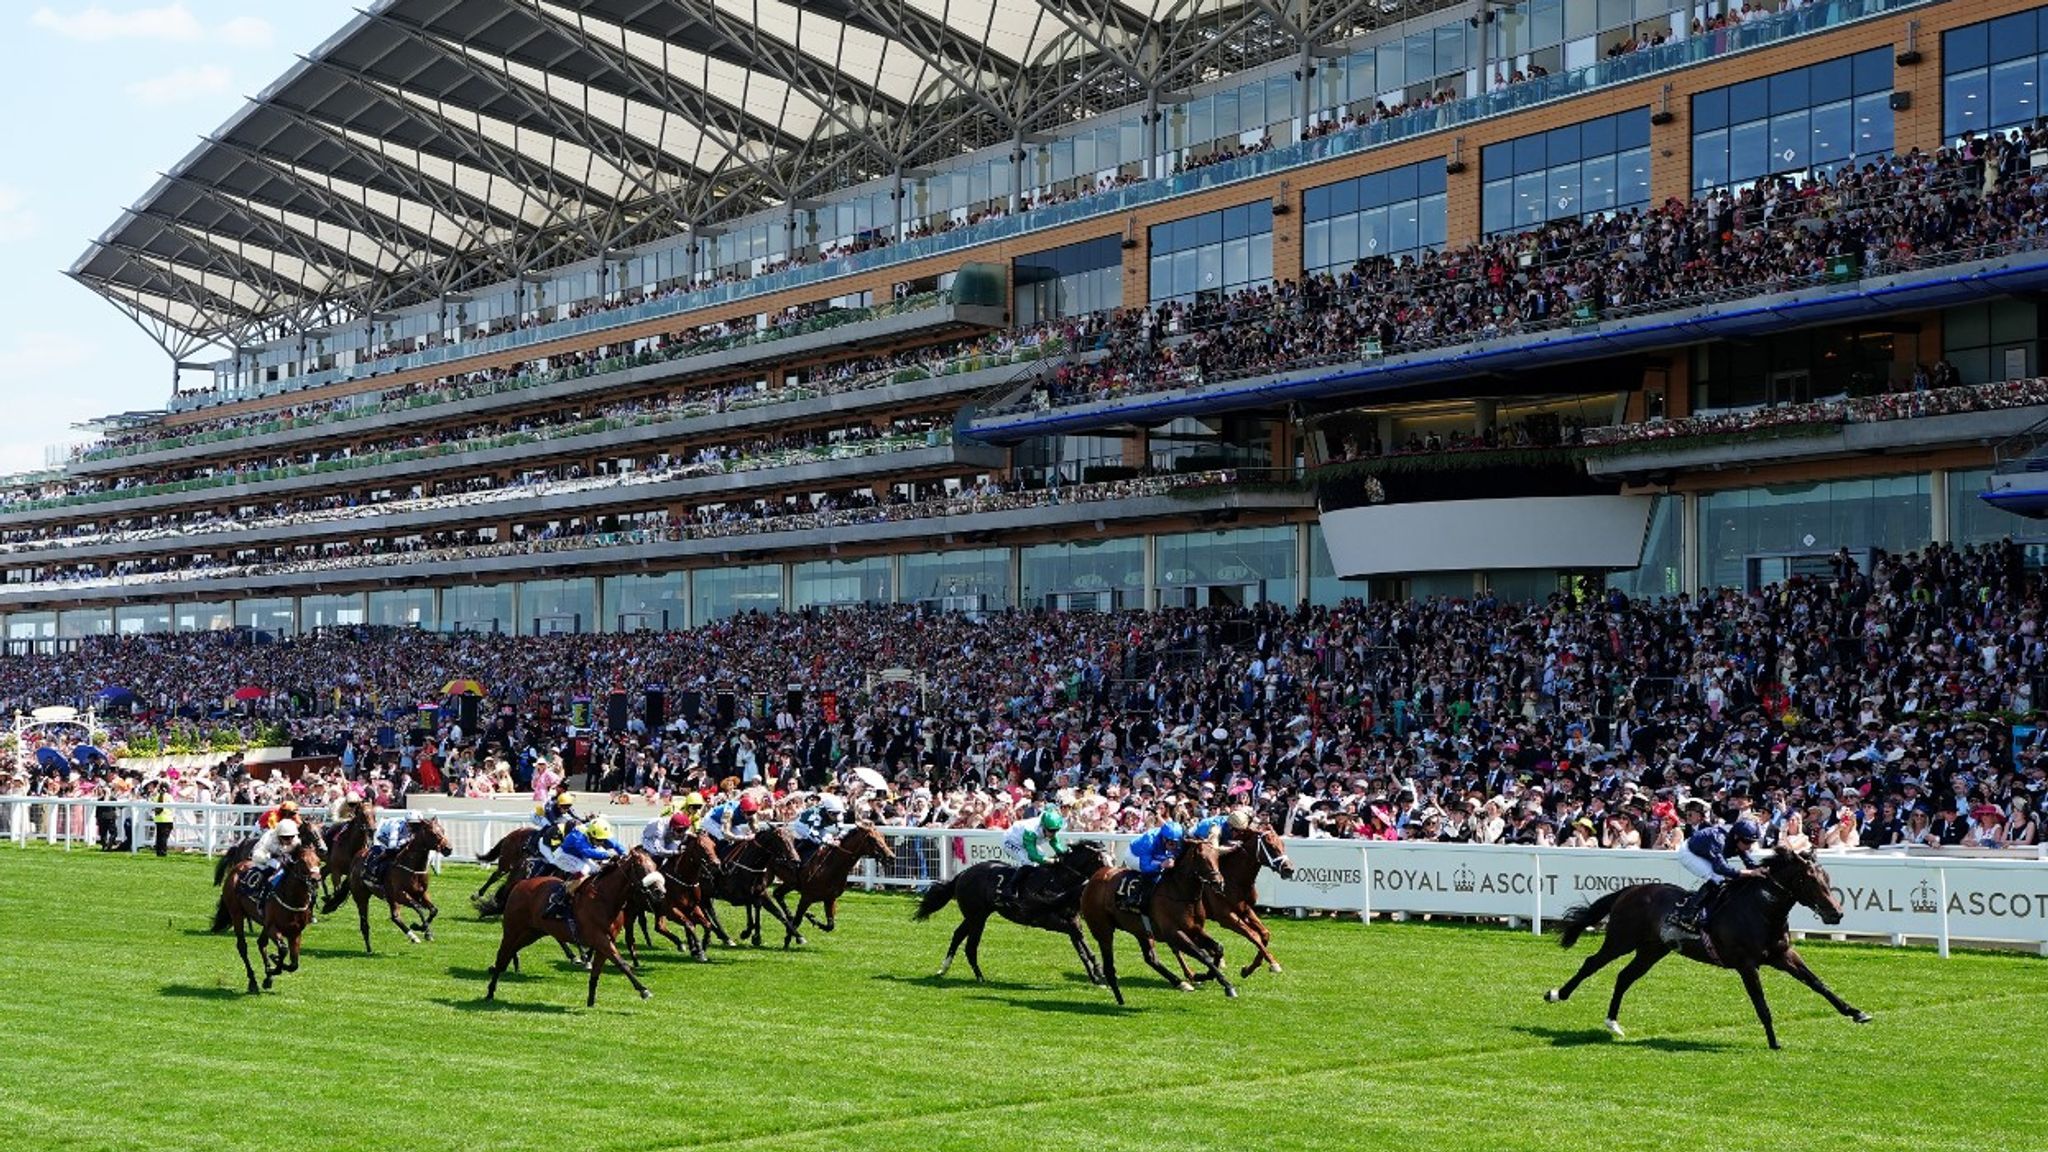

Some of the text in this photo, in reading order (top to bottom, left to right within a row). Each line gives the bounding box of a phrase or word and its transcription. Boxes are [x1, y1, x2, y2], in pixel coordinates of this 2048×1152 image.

[1374, 869, 1558, 895] ROYAL ASCOT
[1829, 887, 2048, 918] OYAL ASCOT
